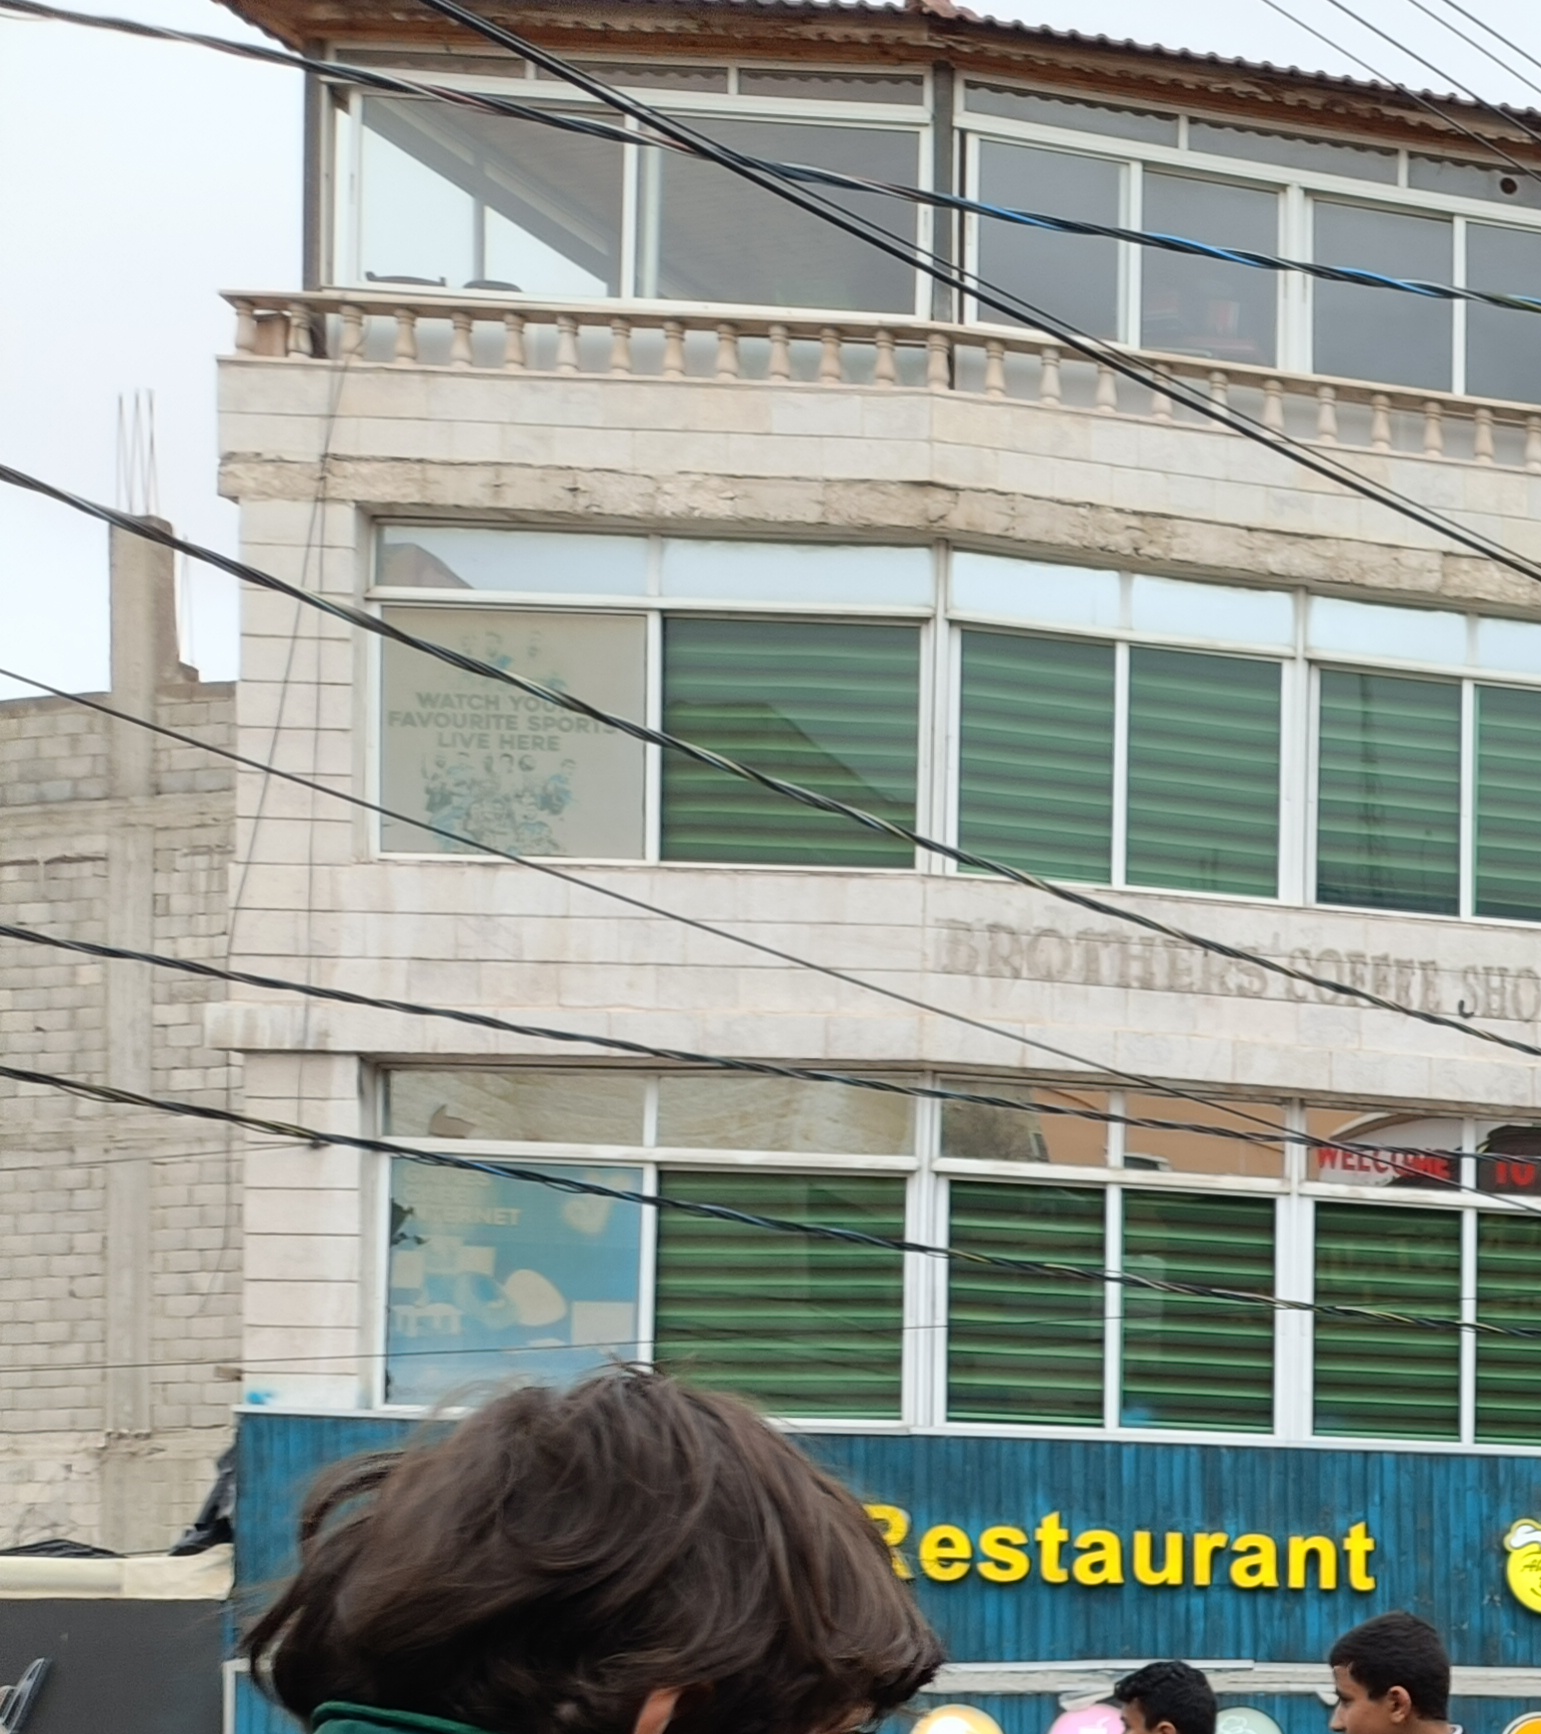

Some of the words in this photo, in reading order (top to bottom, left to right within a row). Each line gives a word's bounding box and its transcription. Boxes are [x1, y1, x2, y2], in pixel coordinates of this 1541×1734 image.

[416, 692, 503, 712] WATCH
[507, 695, 567, 714] YOU
[388, 711, 519, 731] FAVOURITE
[438, 732, 491, 750] LIVE
[500, 734, 561, 752] HERE
[1496, 1160, 1536, 1187] TO
[866, 1503, 1378, 1592] Restaurant
